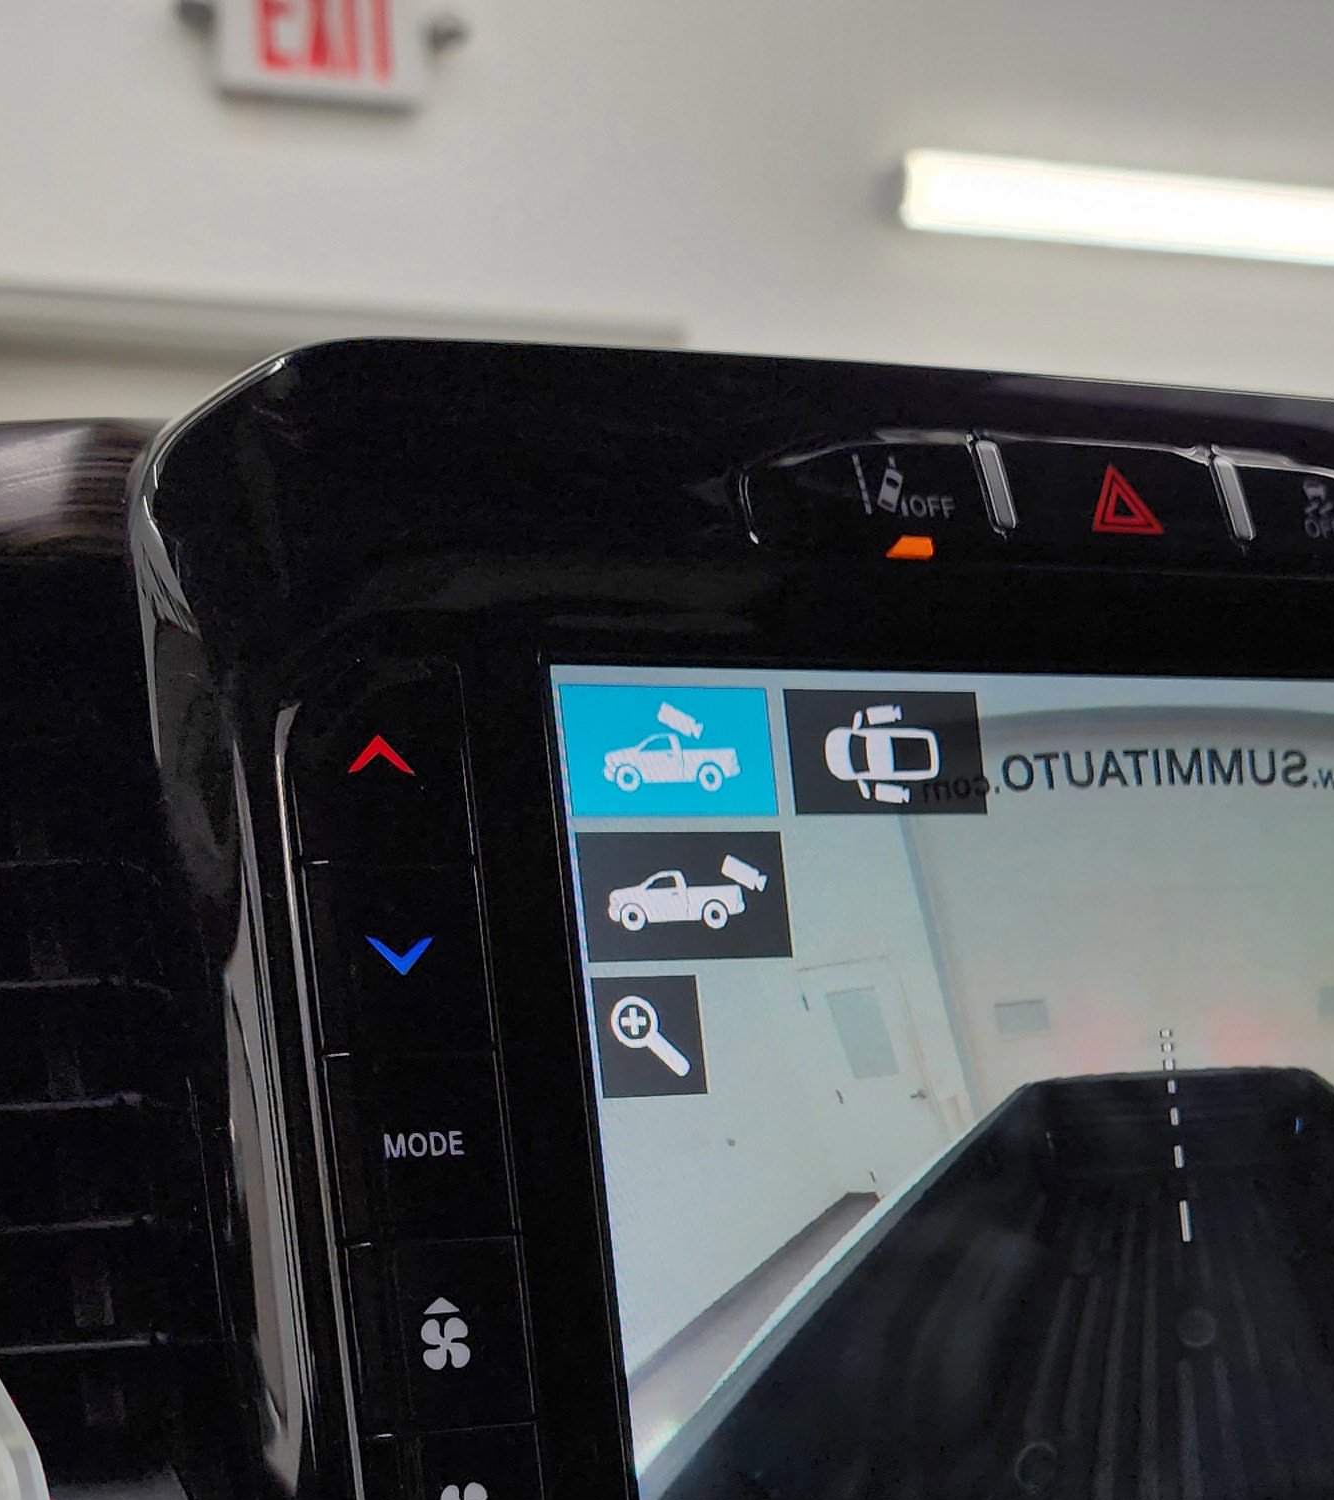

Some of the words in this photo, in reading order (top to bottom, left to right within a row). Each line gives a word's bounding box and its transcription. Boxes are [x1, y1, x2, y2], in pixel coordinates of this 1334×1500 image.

[253, 0, 395, 85] EXIT
[909, 494, 957, 520] OFF
[383, 1129, 465, 1160] MODE
